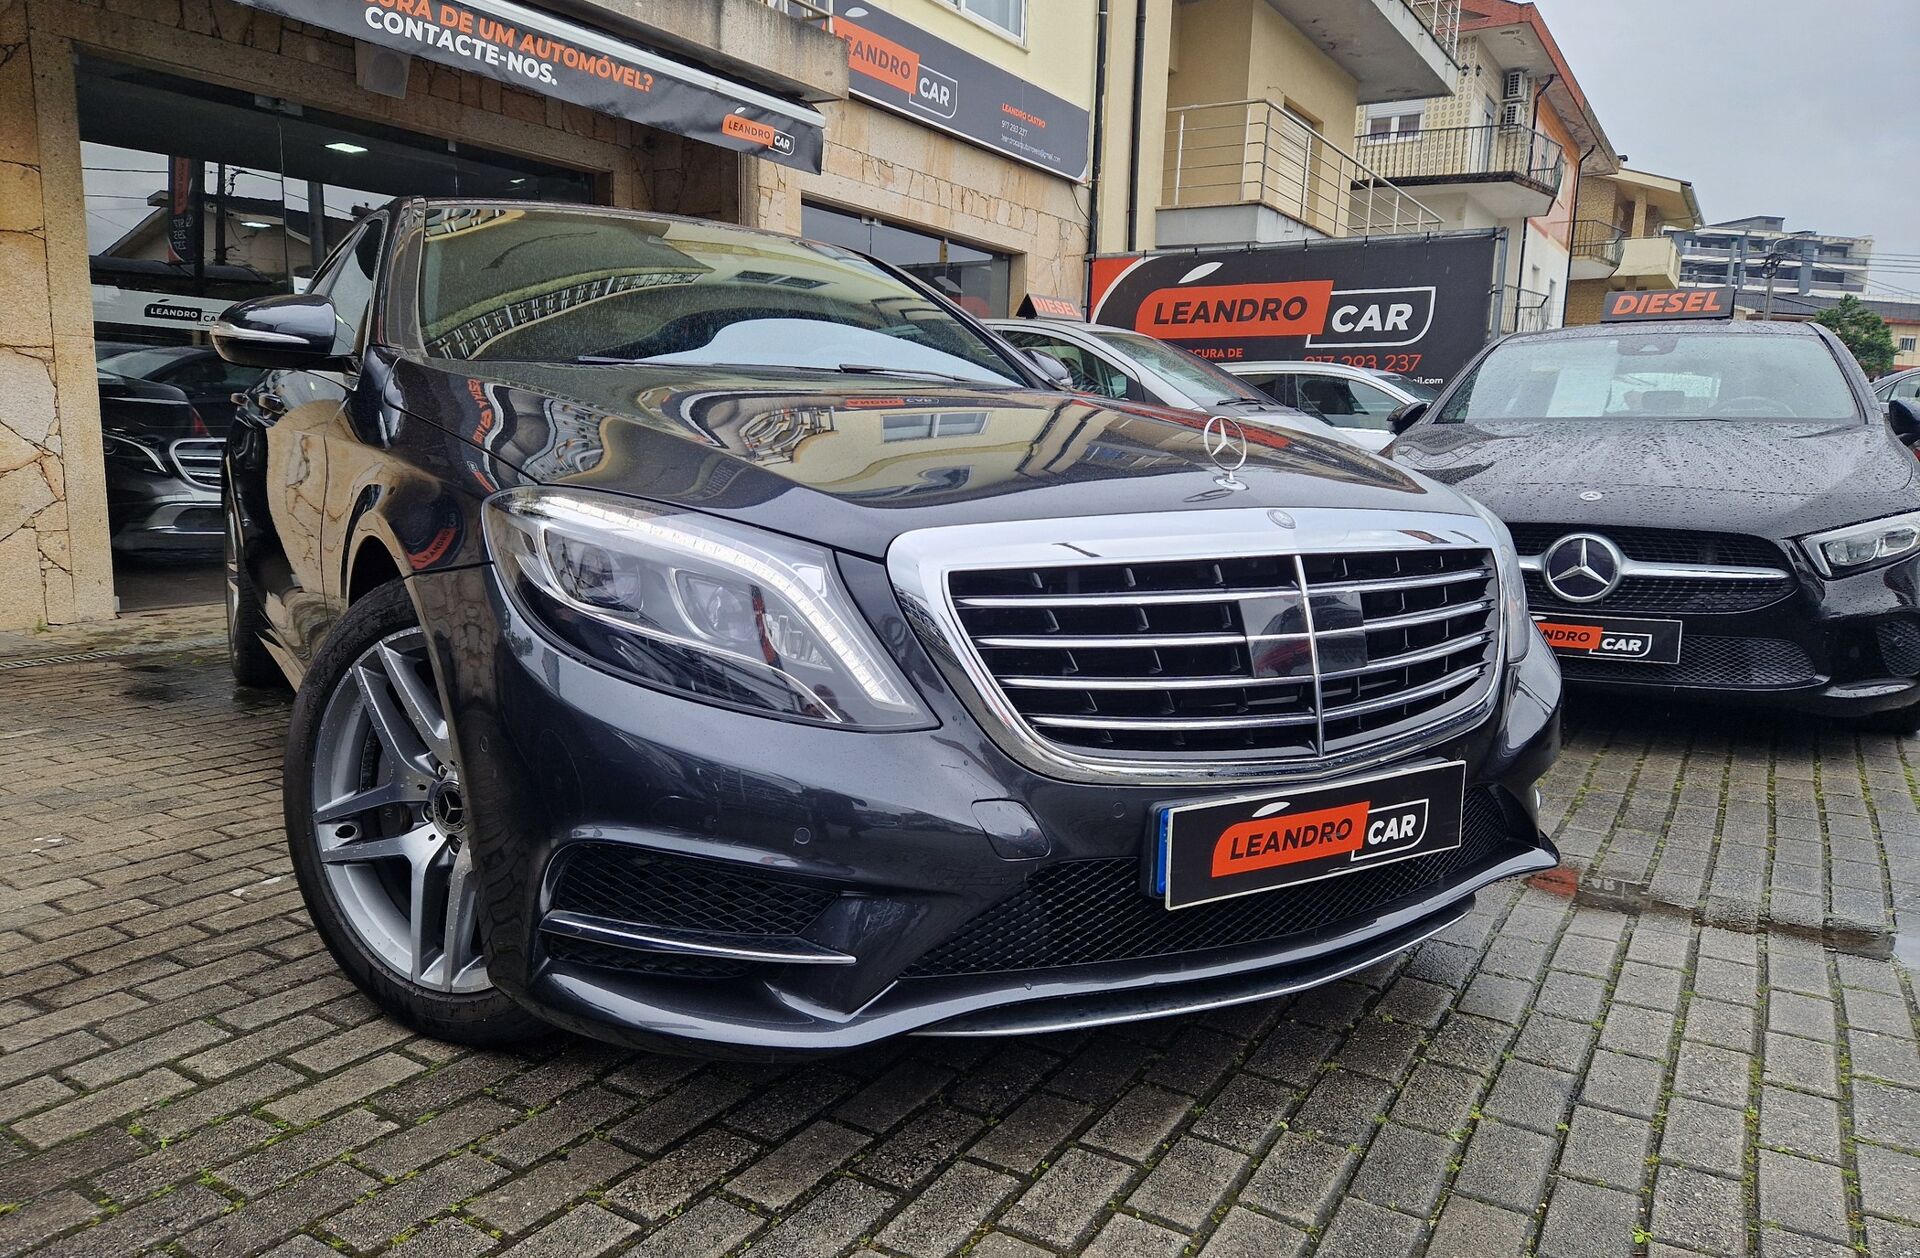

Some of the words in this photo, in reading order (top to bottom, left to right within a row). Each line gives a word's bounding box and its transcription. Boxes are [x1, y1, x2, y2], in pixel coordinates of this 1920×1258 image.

[365, 6, 558, 86] CONTACTE-NOS.
[440, 4, 474, 35] DE
[479, 17, 516, 49] UM
[519, 33, 654, 92] AUTOMÓVEL?
[919, 77, 950, 107] CAR
[728, 120, 771, 140] LEANDRO
[774, 135, 790, 149] CAR
[150, 307, 198, 318] LEANDRO
[1033, 297, 1082, 316] DIESEL
[1153, 295, 1309, 326] LEANDRO
[1331, 303, 1413, 333] CAR
[1612, 291, 1721, 315] DIESEL
[1228, 348, 1244, 358] DE
[1384, 354, 1423, 372] 237
[1601, 637, 1642, 652] CAR
[1230, 818, 1353, 861] LEANDRO
[1367, 813, 1417, 846] CAR
